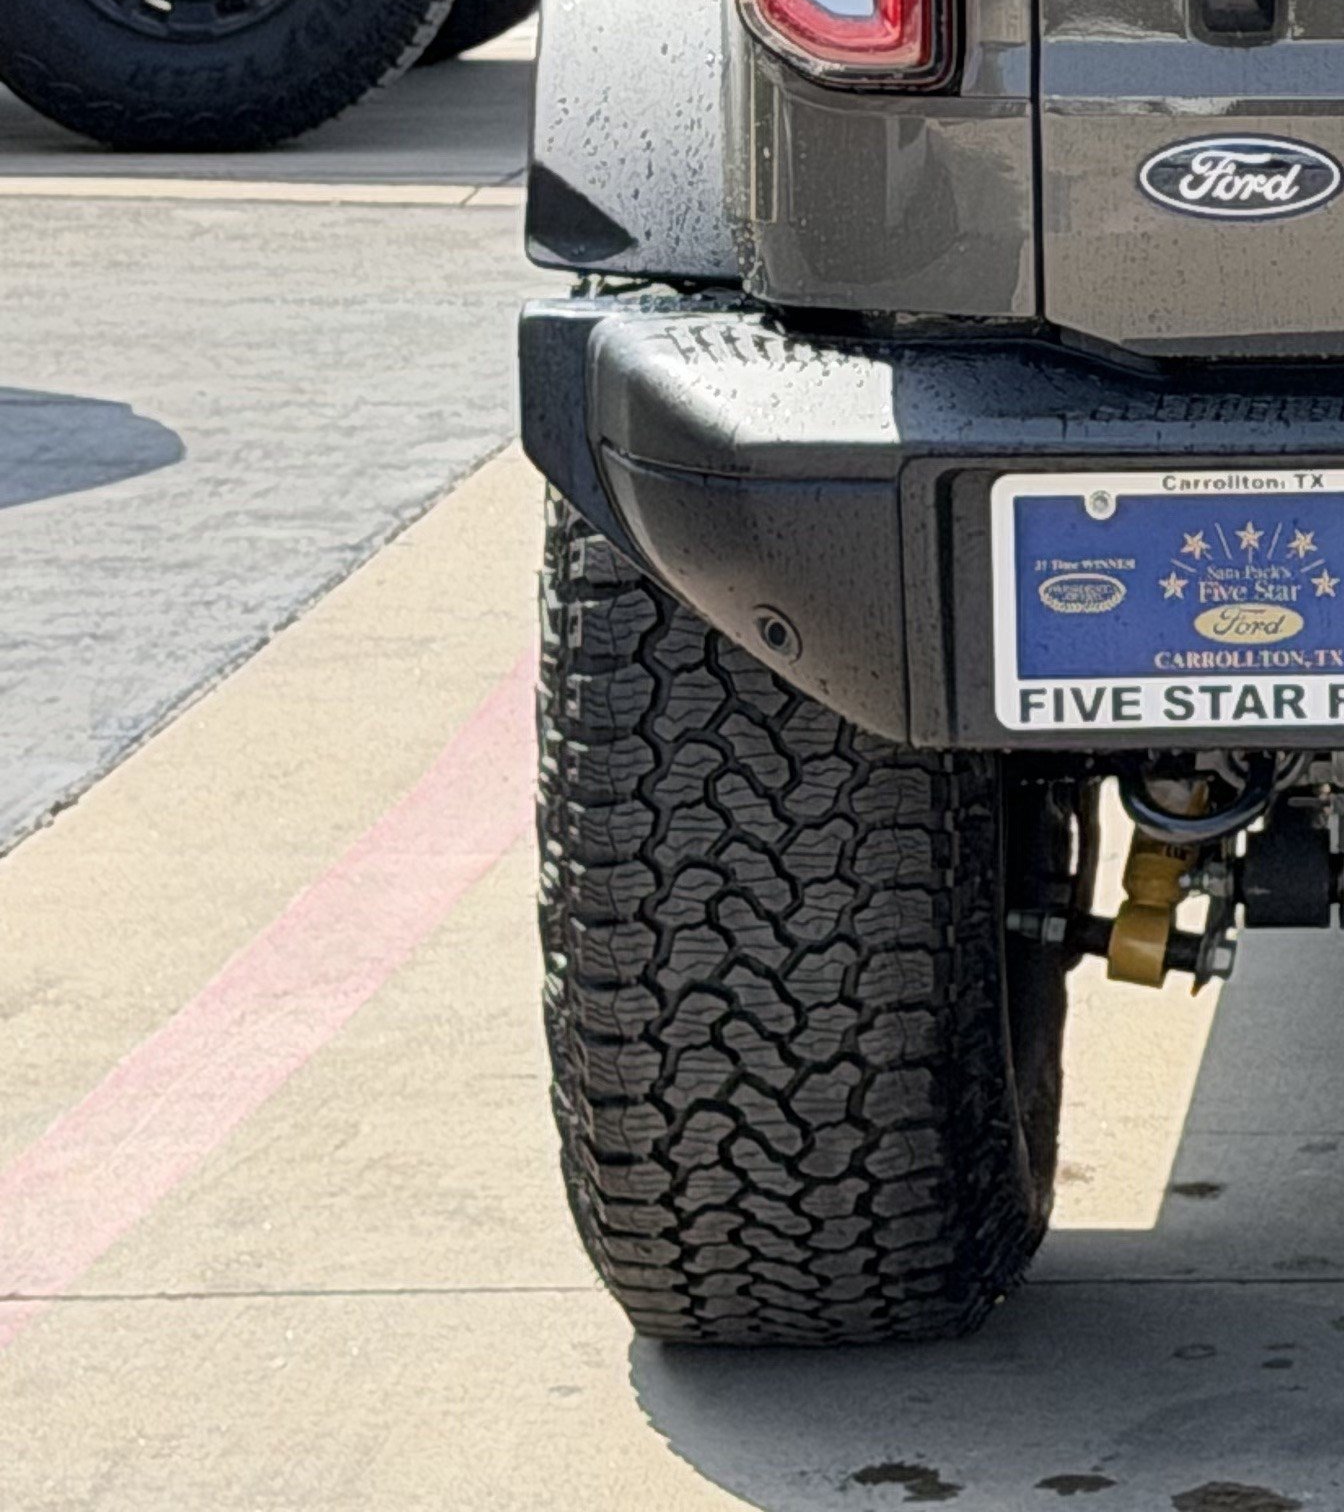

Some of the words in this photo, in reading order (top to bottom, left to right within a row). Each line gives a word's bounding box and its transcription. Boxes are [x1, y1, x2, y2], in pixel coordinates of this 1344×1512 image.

[1178, 149, 1302, 201] Ford
[1294, 473, 1325, 489] TX
[1198, 580, 1248, 603] Five
[1254, 579, 1301, 602] Star
[1212, 607, 1287, 636] Ford
[1018, 686, 1142, 723] FIVE
[1162, 684, 1306, 721] STAR
